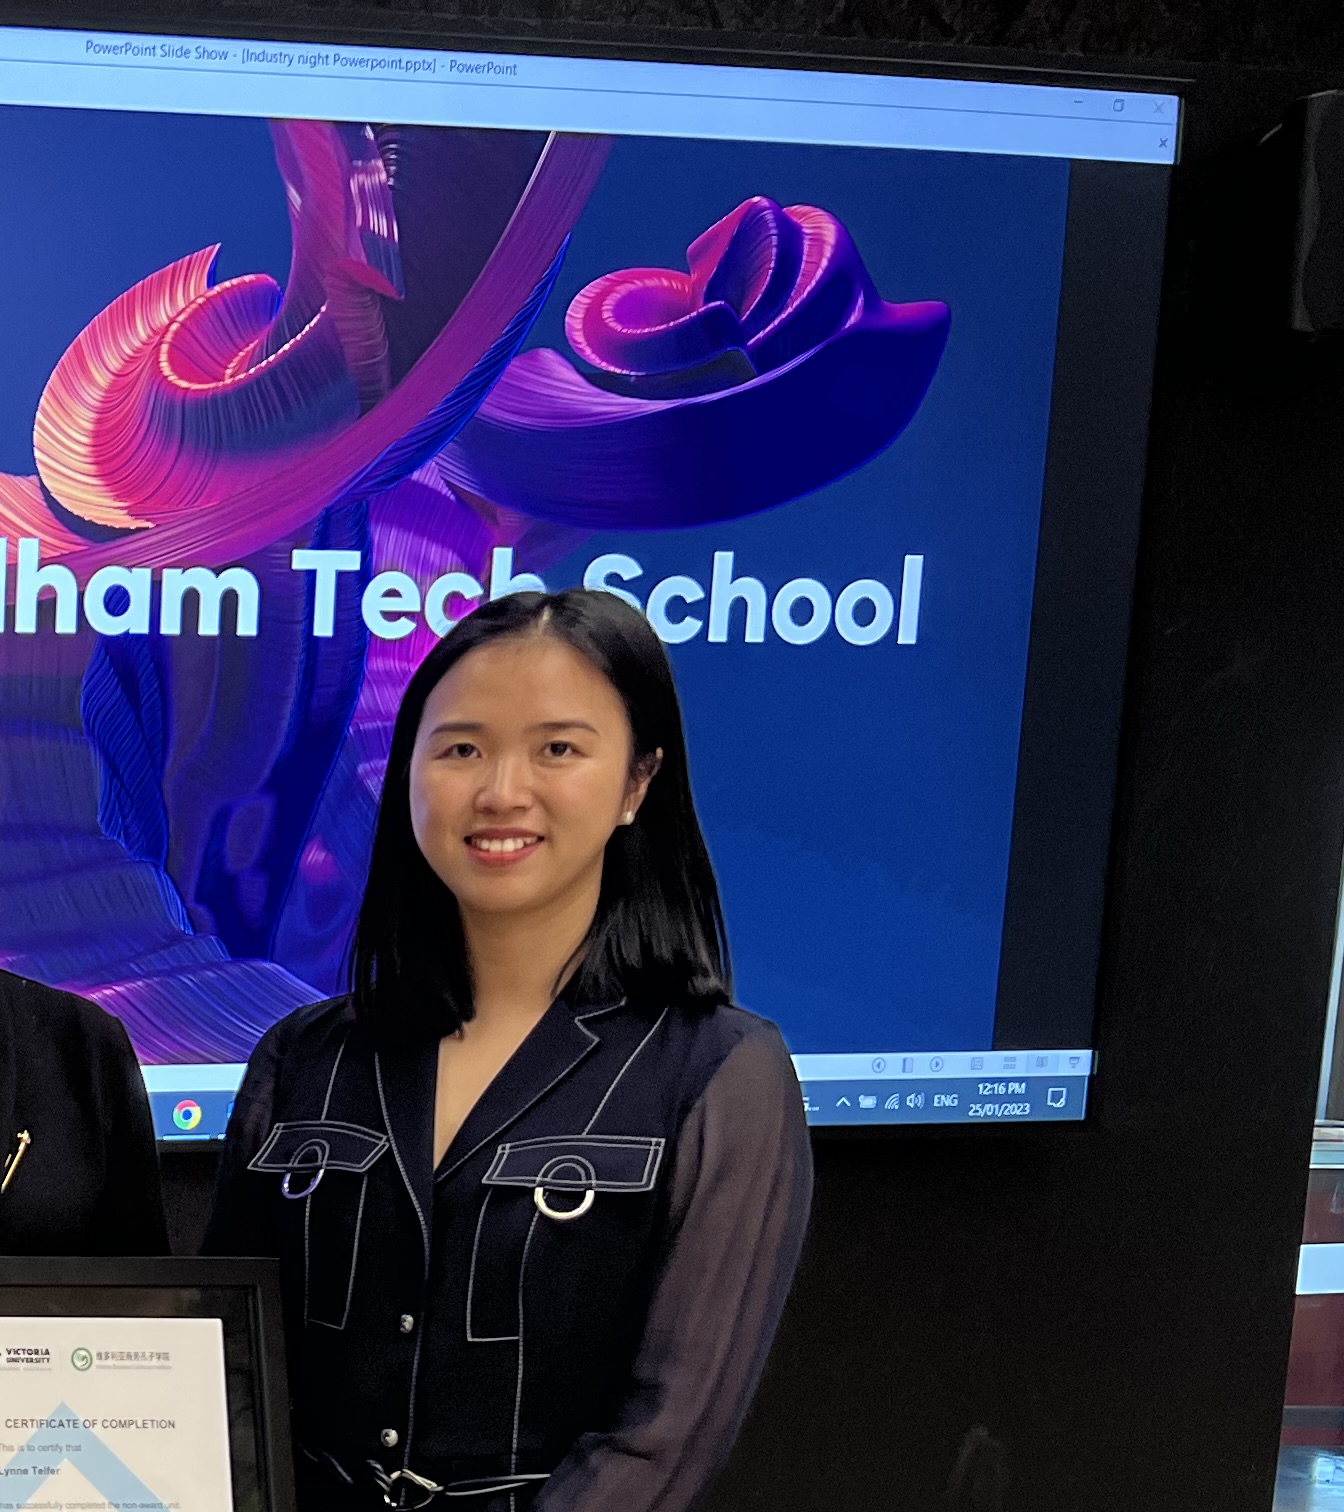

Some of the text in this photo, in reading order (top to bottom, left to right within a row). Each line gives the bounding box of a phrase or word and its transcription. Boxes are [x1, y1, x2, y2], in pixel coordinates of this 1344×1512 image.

[85, 39, 156, 57] PowerPoint
[160, 44, 191, 59] Slide
[194, 45, 228, 61] Show
[297, 51, 329, 69] night
[450, 59, 517, 76] PowerPoint
[978, 1081, 1026, 1095] 12:16 PM
[933, 1094, 959, 1108] ENG
[968, 1102, 1030, 1117] 25/01/2023
[6, 1348, 51, 1356] VICTORIA
[5, 1418, 176, 1430] CERTIFICATE OF COMPLETION
[27, 1443, 36, 1452] to
[38, 1443, 63, 1454] certify
[66, 1443, 82, 1452] that
[31, 1466, 61, 1476] Telfer
